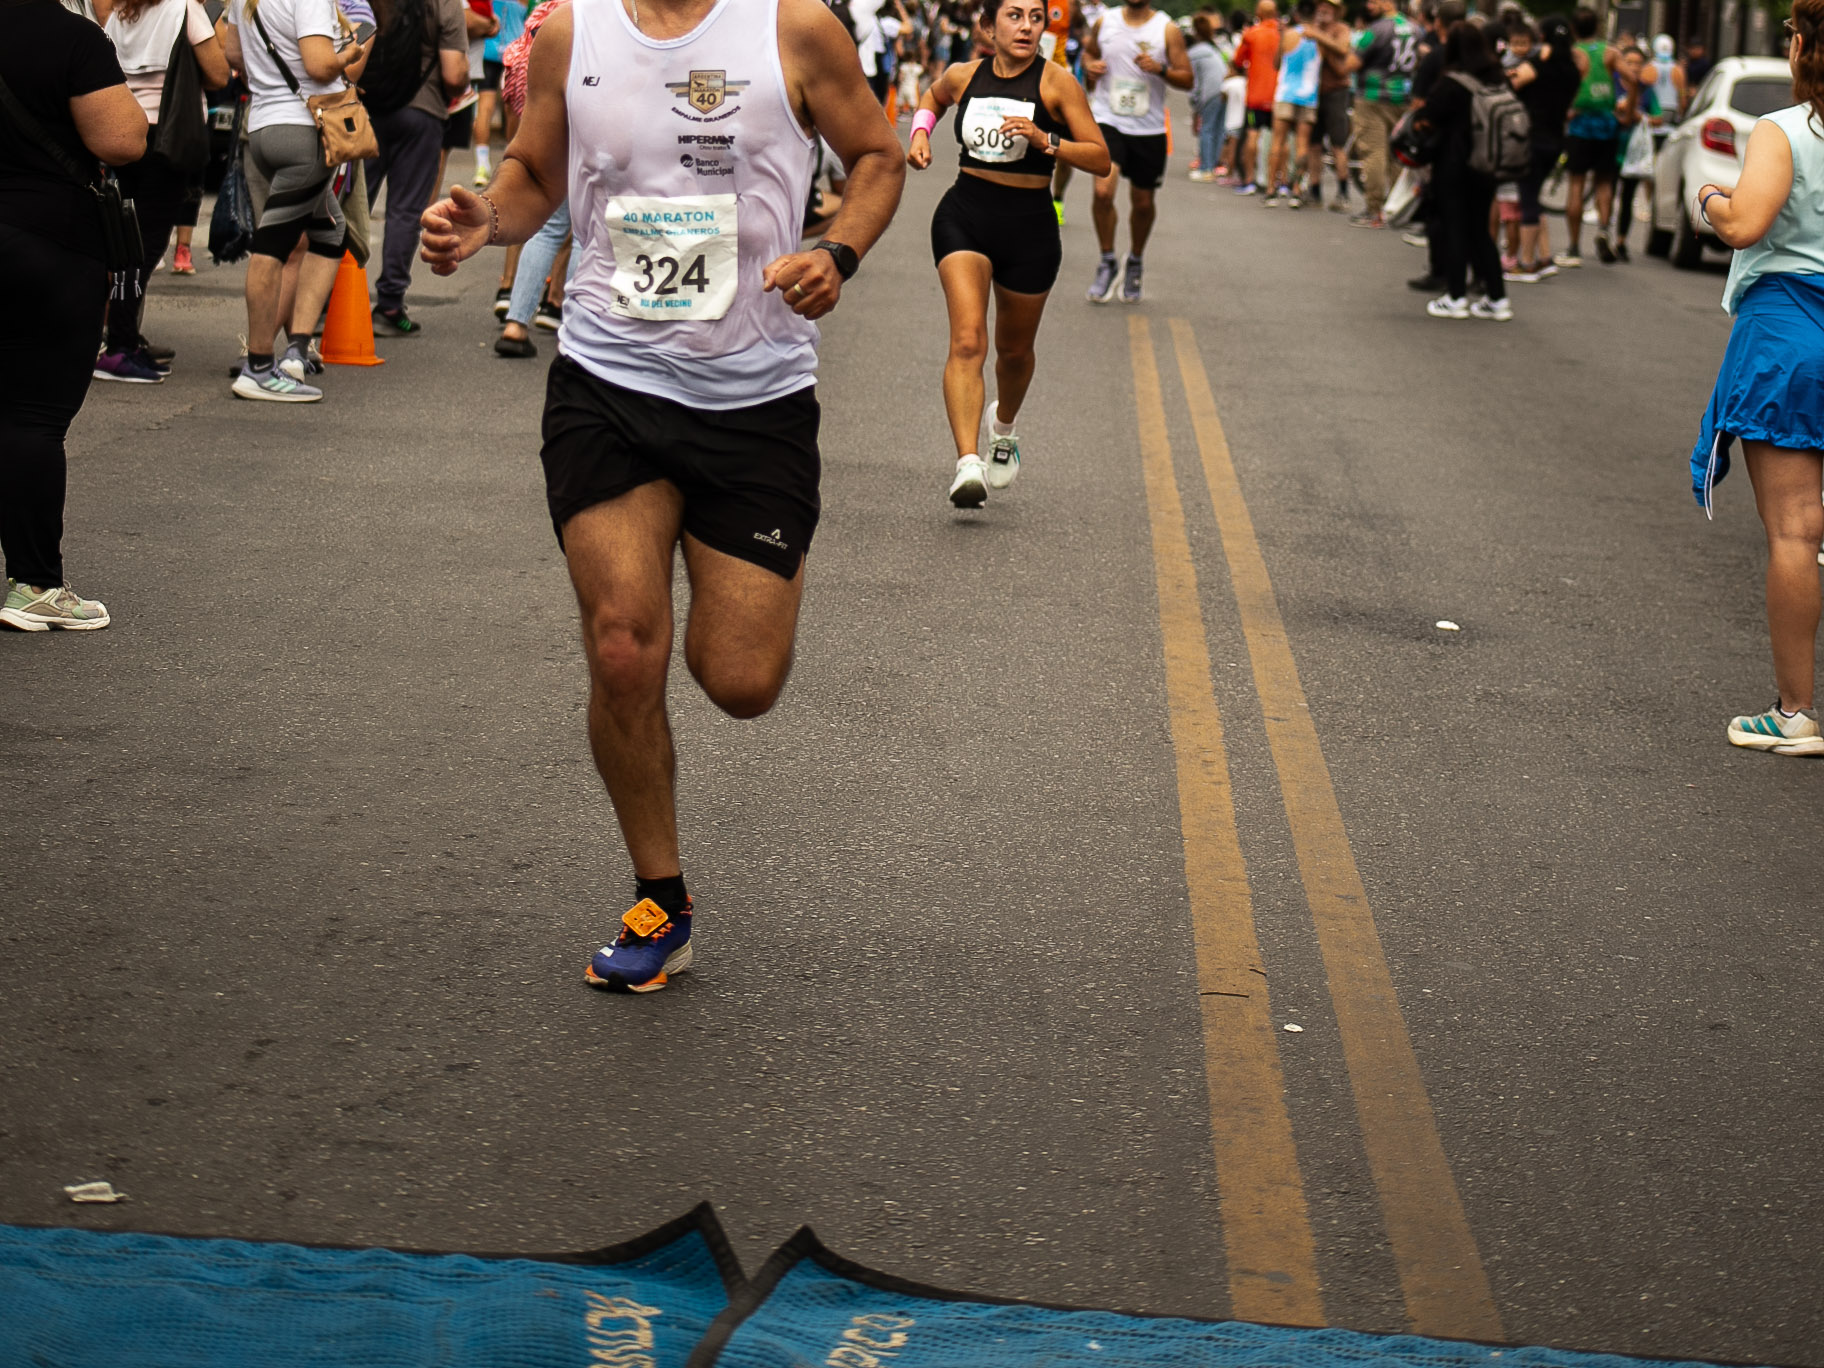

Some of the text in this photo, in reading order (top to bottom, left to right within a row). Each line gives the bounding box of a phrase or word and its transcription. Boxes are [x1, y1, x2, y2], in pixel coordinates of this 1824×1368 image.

[696, 93, 717, 105] 40
[671, 105, 741, 123] EMPALME GRANEROS
[696, 158, 719, 167] Banco
[697, 166, 734, 176] Municipal
[623, 211, 715, 223] 40 MARATON
[633, 254, 710, 295] 324
